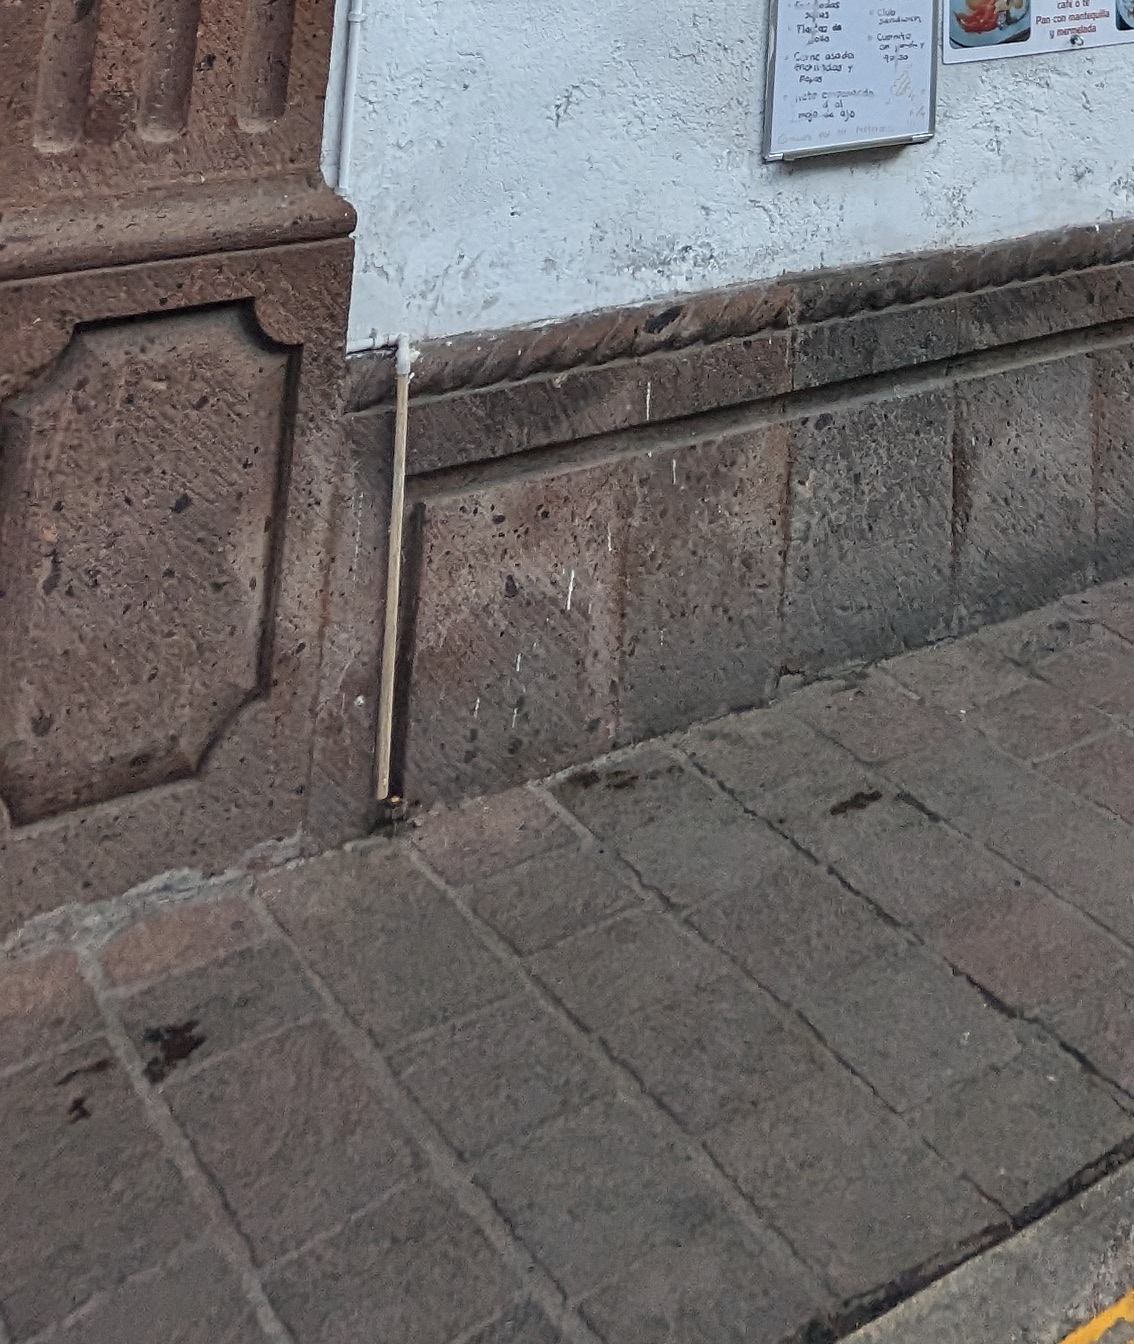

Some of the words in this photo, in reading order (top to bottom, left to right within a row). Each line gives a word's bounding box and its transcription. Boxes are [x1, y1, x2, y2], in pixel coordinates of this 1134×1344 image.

[1036, 15, 1051, 25] Pan
[1053, 15, 1066, 24] con
[1068, 9, 1110, 21] mantequilla
[1056, 24, 1097, 36] mermelada
